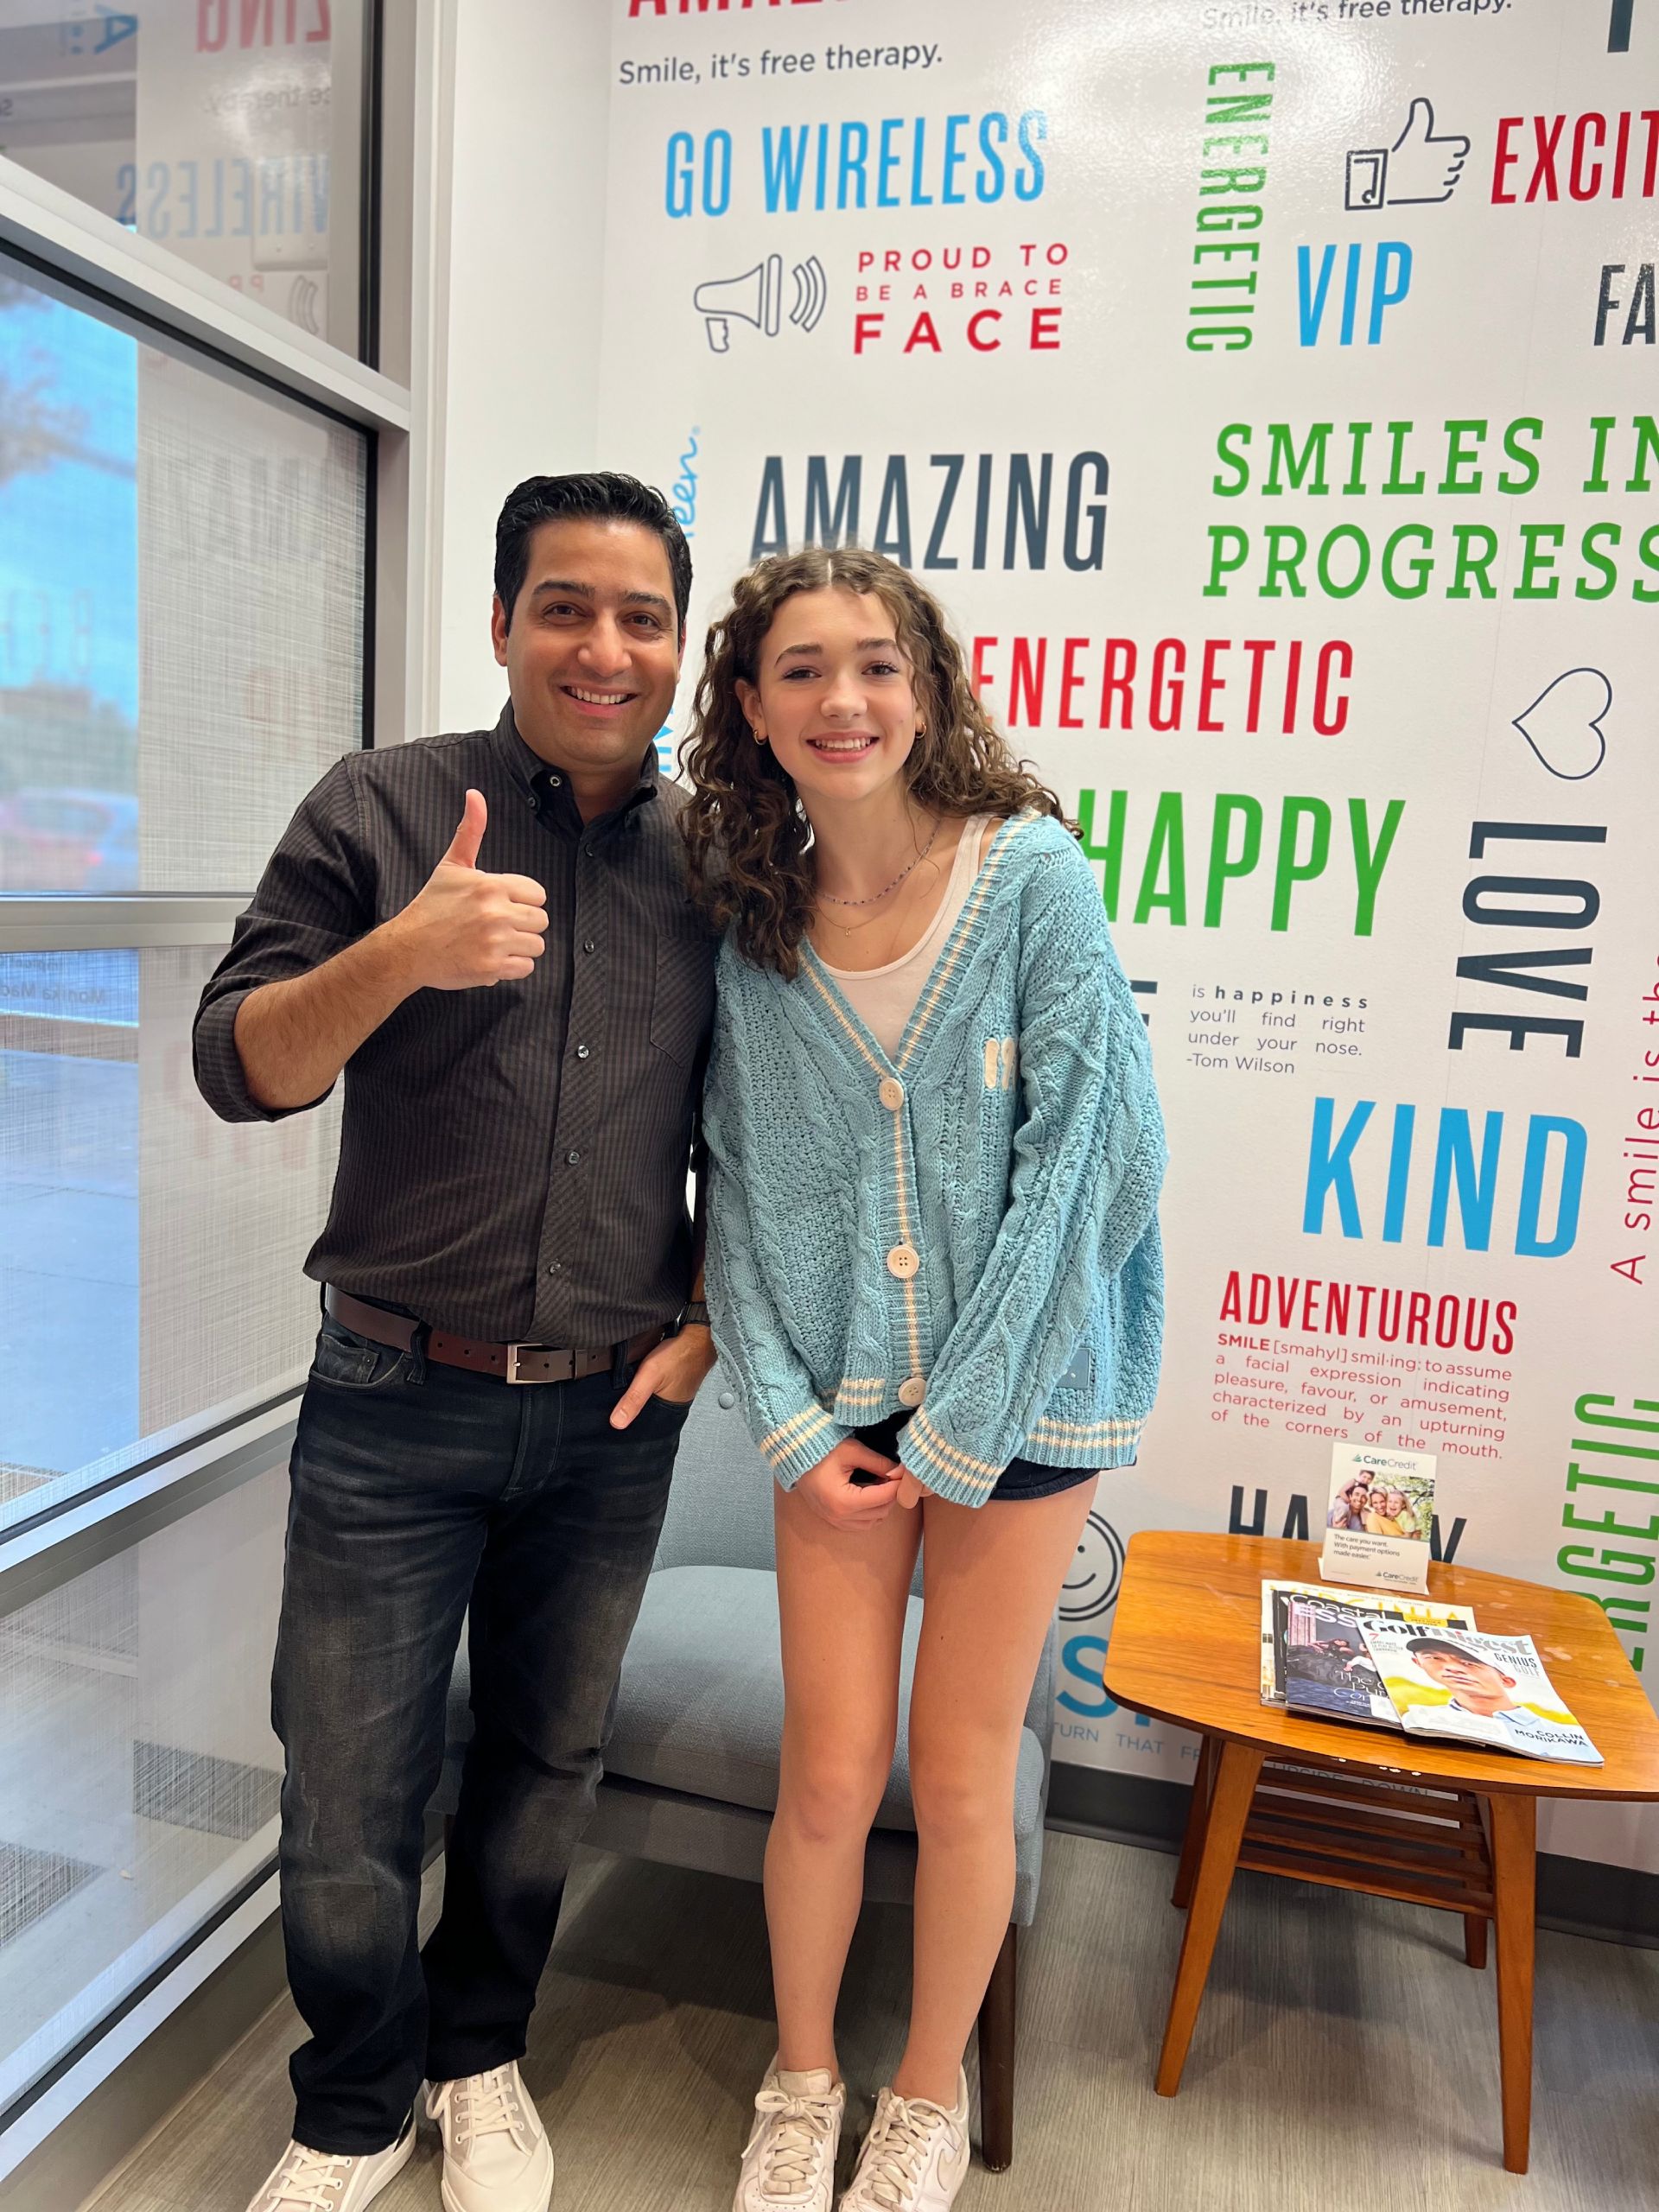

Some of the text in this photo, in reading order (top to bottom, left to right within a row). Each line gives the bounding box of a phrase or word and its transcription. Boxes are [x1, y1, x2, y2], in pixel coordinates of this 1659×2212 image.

[1338, 0, 1392, 19] free
[619, 43, 943, 85] Smile, it's free therapy.
[664, 109, 1048, 219] GO WIRELESS
[1185, 61, 1275, 352] ENERGETIC
[858, 243, 1068, 273] PROUD TO
[855, 278, 1062, 302] BE A BRACE
[1297, 241, 1413, 346] VIP
[854, 307, 1063, 355] FACE
[1212, 416, 1544, 497] SMILES
[749, 450, 1109, 572] AMAZING
[1202, 522, 1659, 603] PROGRESS
[970, 636, 1353, 736] ENERGETIC
[1077, 789, 1406, 937] HAPPY
[1447, 821, 1608, 1058] LOVE
[1192, 984, 1368, 1009] is happiness
[1188, 1033, 1363, 1056] under your nose.
[1190, 1009, 1365, 1033] you'll find right
[1186, 1052, 1295, 1074] -Tom Wilson
[1610, 954, 1659, 1285] A smile is th
[1302, 1096, 1588, 1260] KIND
[1219, 1270, 1517, 1356] ADVENTUROUS
[1216, 1355, 1510, 1402] a facial expression indicating
[1217, 1333, 1270, 1351] SMILE
[1274, 1340, 1347, 1363] [smahyl]
[1425, 1359, 1442, 1372] to
[1446, 1364, 1512, 1381] assume
[1212, 1390, 1505, 1442] characterized by an upturning
[1214, 1372, 1507, 1421] pleasure, favour, or amusement,
[1211, 1409, 1503, 1459] of the corners of the mouth.
[1363, 1455, 1417, 1470] CareCredit
[1557, 1393, 1659, 1672] RGETIC
[1494, 1652, 1537, 1669] GENIUS
[1116, 1733, 1165, 1755] THAT
[1515, 1729, 1589, 1747] MORIKAWA
[1536, 1730, 1584, 1741] COLLIN
